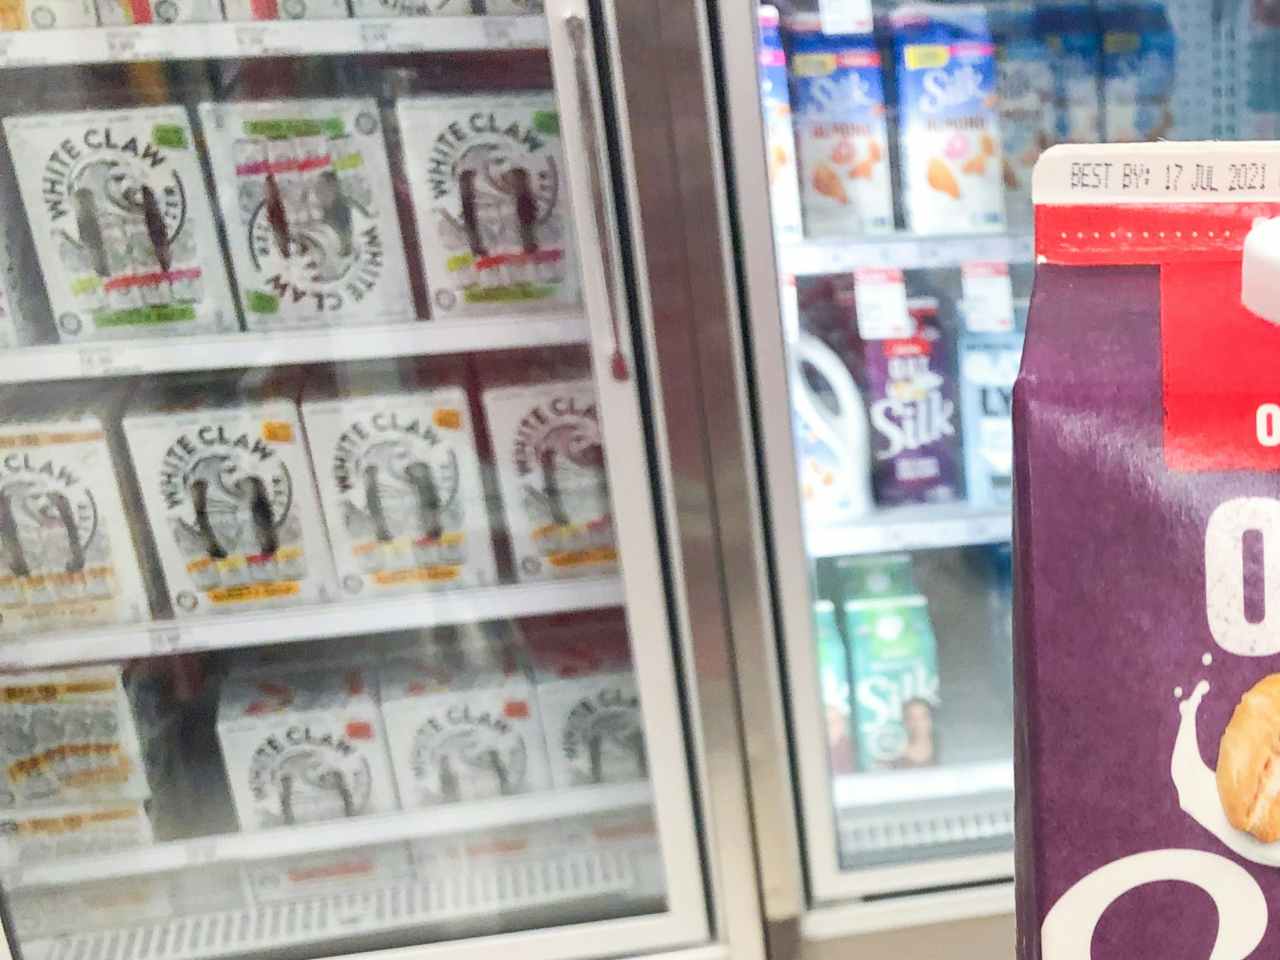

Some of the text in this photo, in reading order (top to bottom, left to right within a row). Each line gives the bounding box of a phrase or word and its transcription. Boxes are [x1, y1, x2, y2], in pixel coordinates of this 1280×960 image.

[43, 128, 167, 221] WHITE CLAW
[428, 121, 467, 199] WHITE
[469, 112, 544, 152] CLAW
[1071, 162, 1113, 190] BEST
[1165, 163, 1183, 191] 17
[1192, 163, 1219, 191] JUL
[1228, 162, 1266, 191] 2021
[333, 422, 370, 494] WHITE
[512, 397, 599, 477] WHITE CLA
[869, 391, 955, 460] Silk
[159, 424, 274, 509] WHITE CLAW
